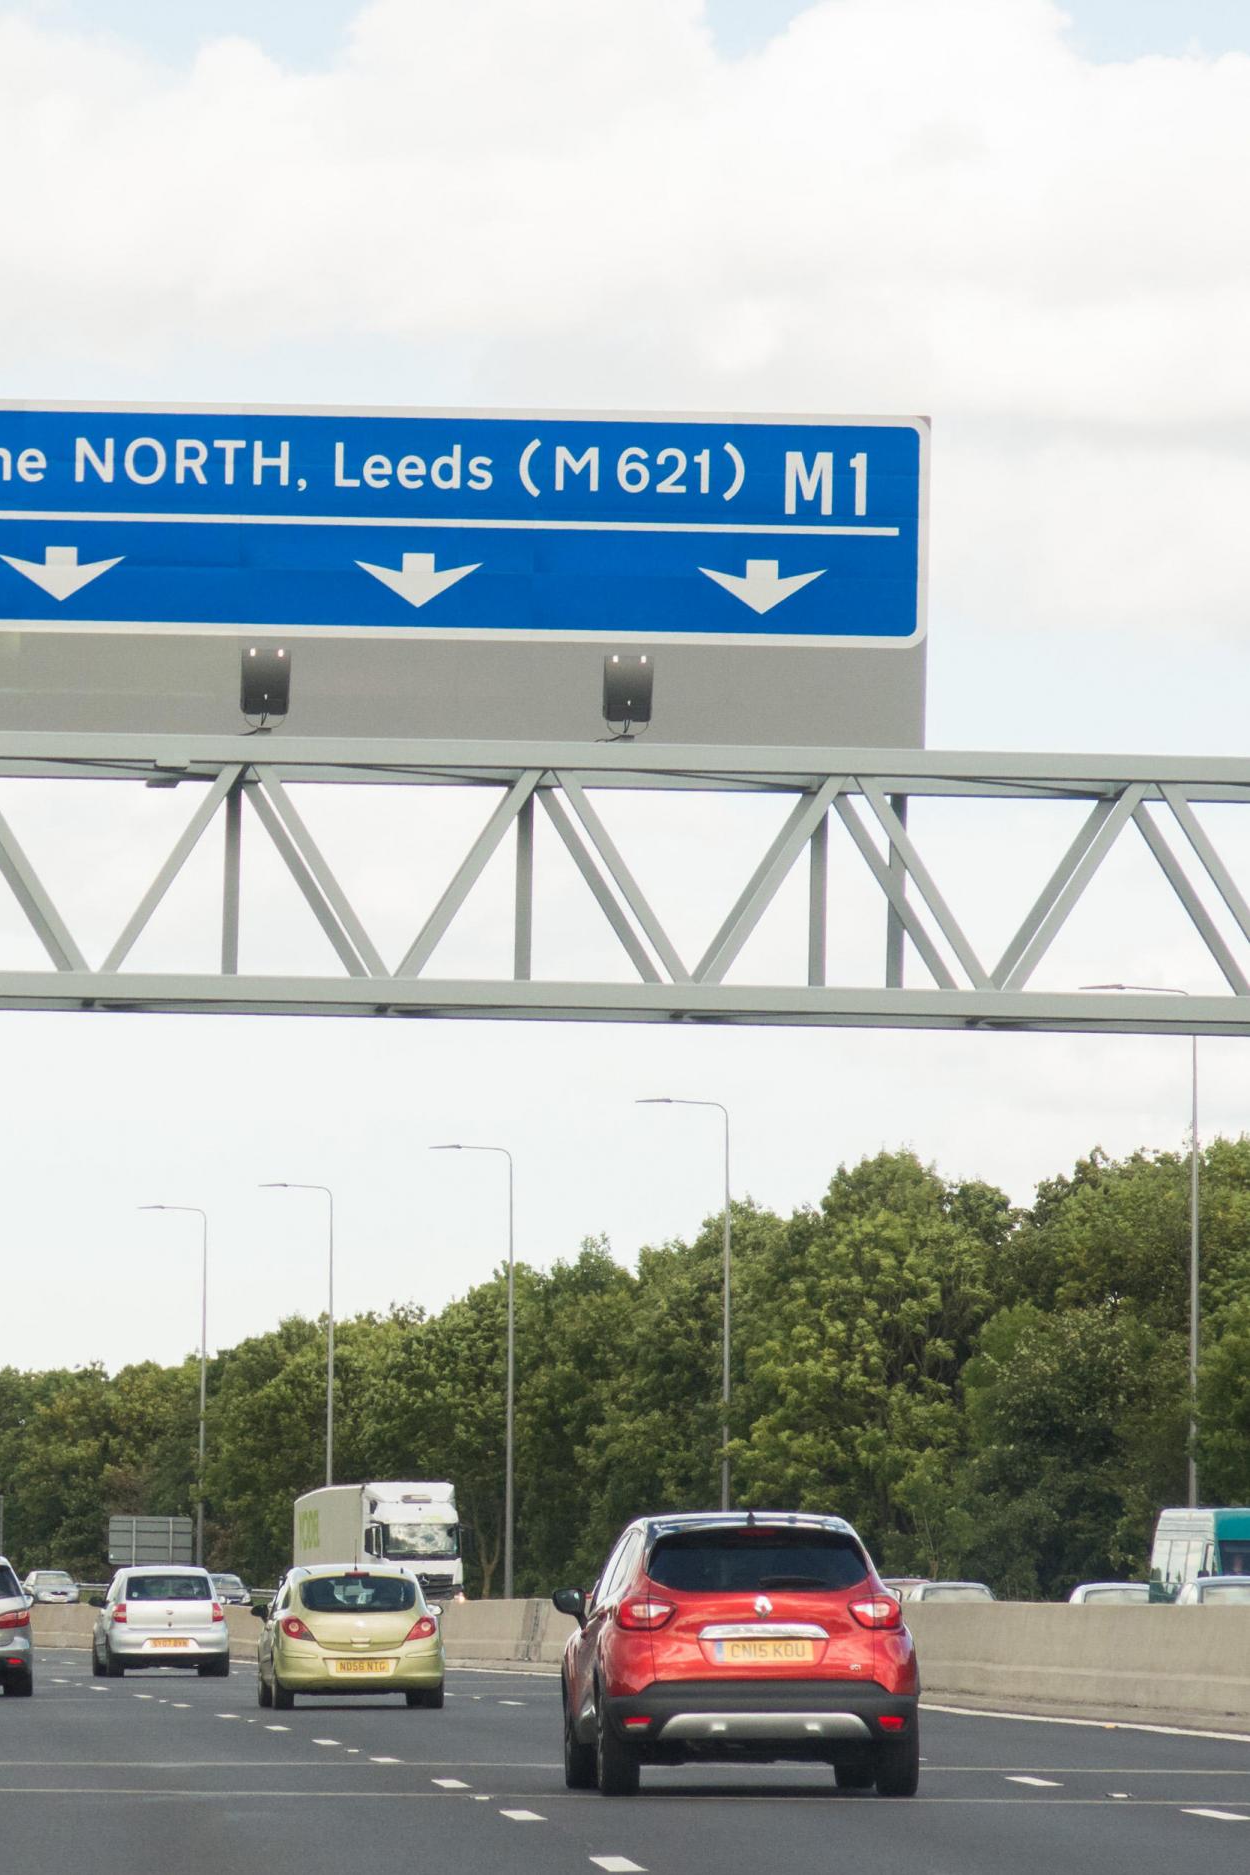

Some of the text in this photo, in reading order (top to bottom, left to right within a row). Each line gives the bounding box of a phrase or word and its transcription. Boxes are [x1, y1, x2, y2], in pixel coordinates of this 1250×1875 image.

[74, 437, 307, 491] NORTH,
[334, 442, 493, 491] Leeds
[784, 451, 867, 516] M1
[730, 1642, 806, 1659] CN15 KOU
